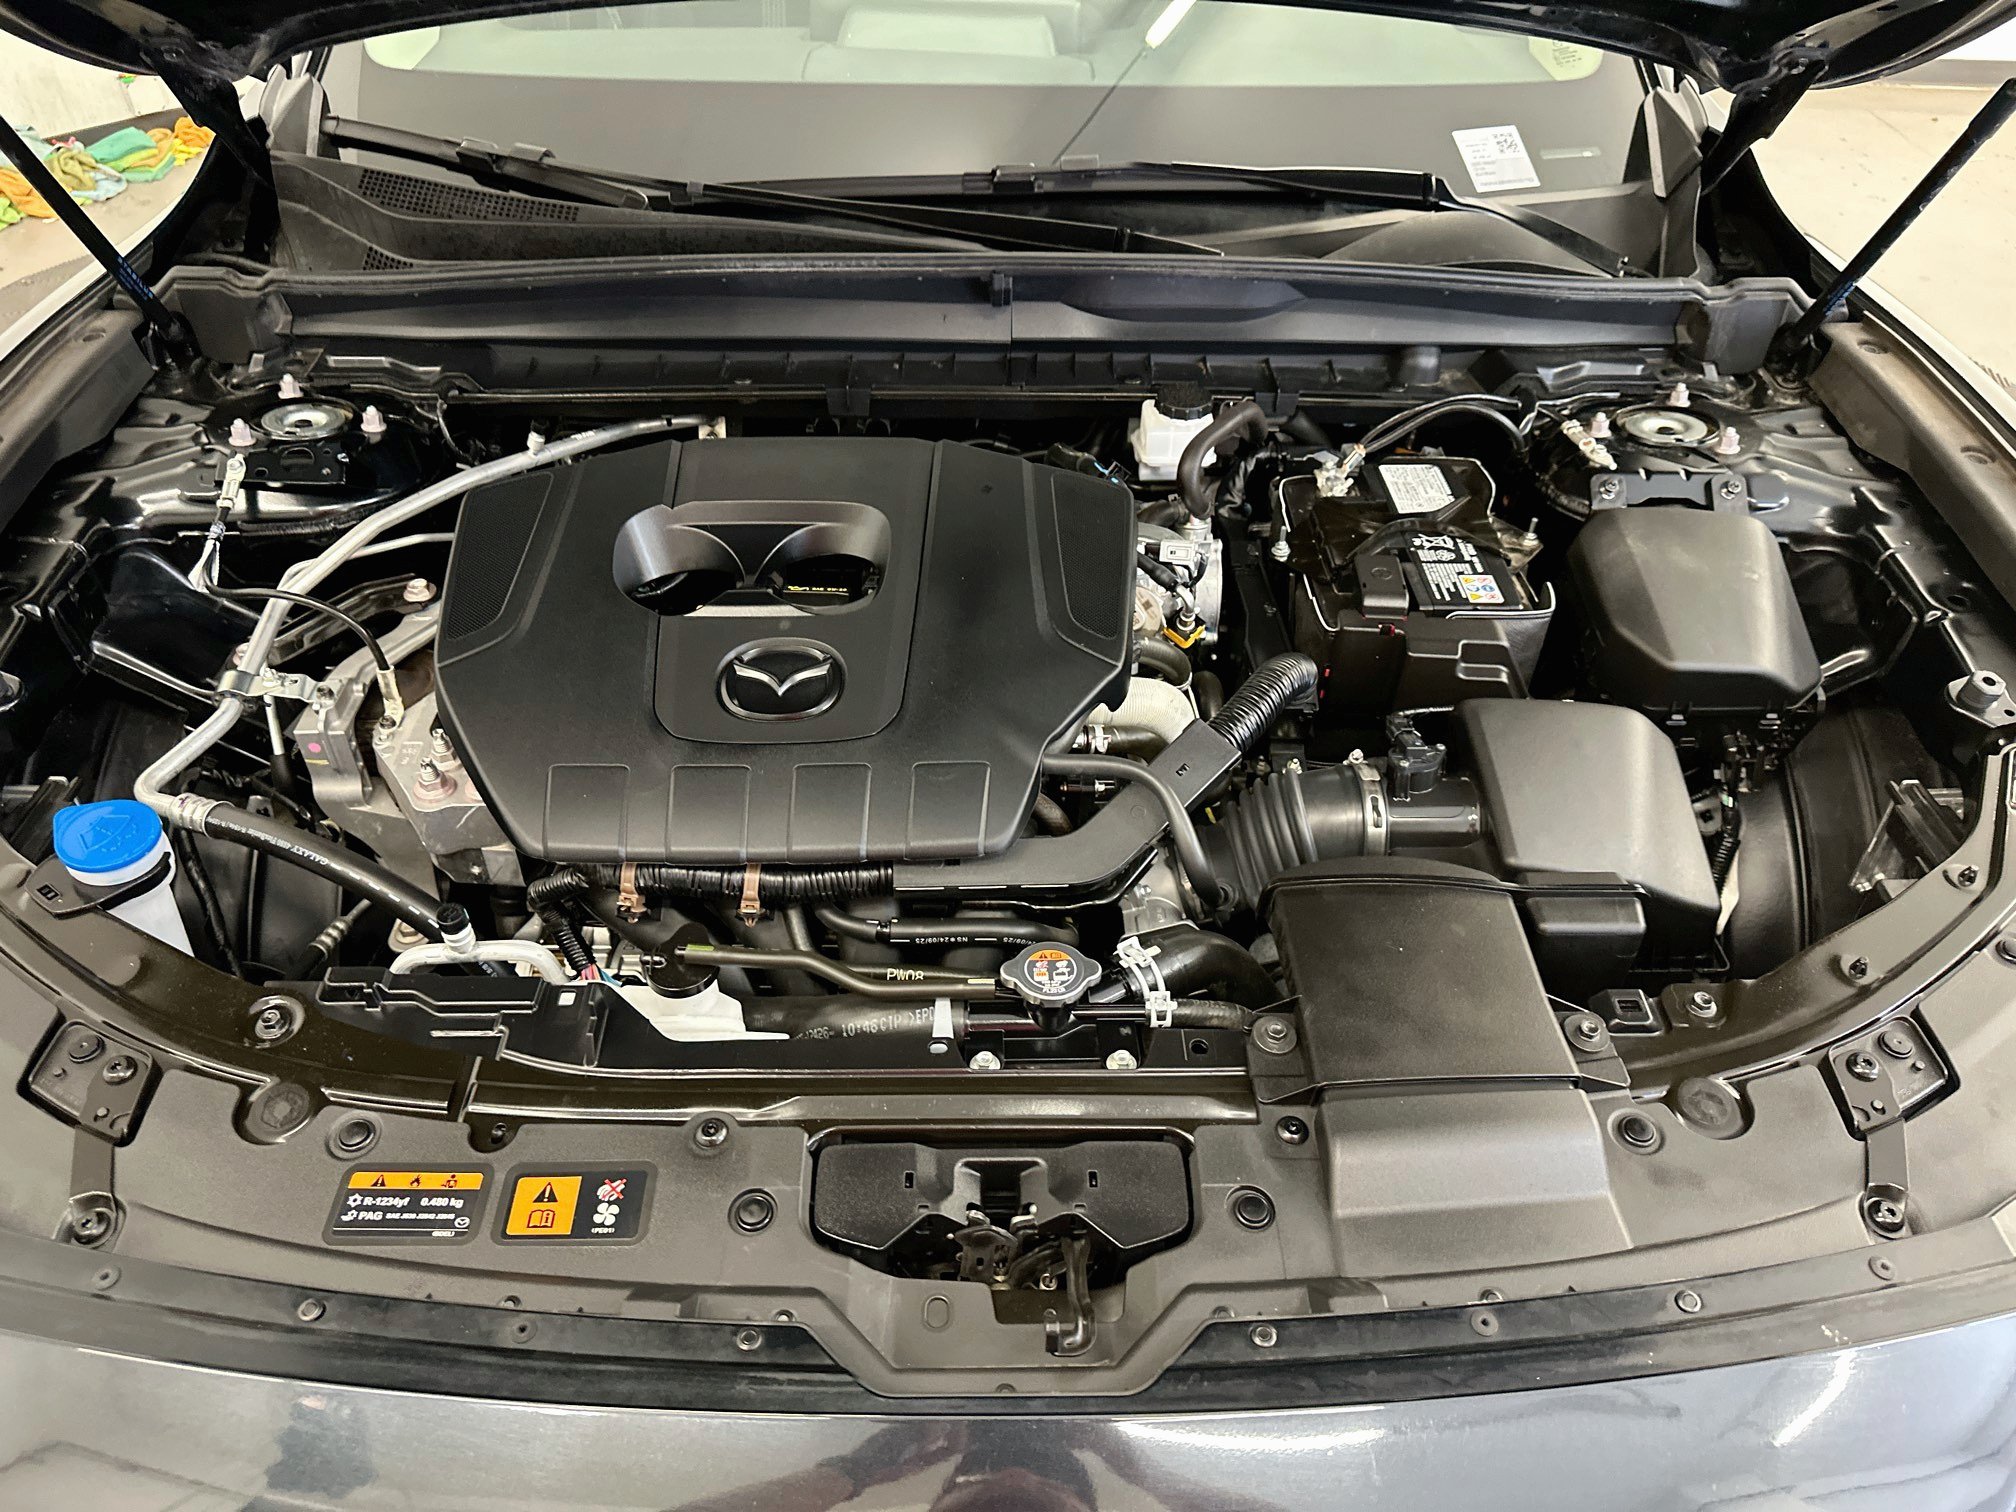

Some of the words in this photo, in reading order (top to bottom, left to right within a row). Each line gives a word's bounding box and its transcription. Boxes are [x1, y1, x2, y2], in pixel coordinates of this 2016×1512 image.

[289, 844, 330, 866] GALAXY
[363, 1197, 410, 1208] R-1234yf
[420, 1198, 449, 1207] 0.480
[449, 1198, 464, 1208] kg
[358, 1211, 383, 1220] PAG
